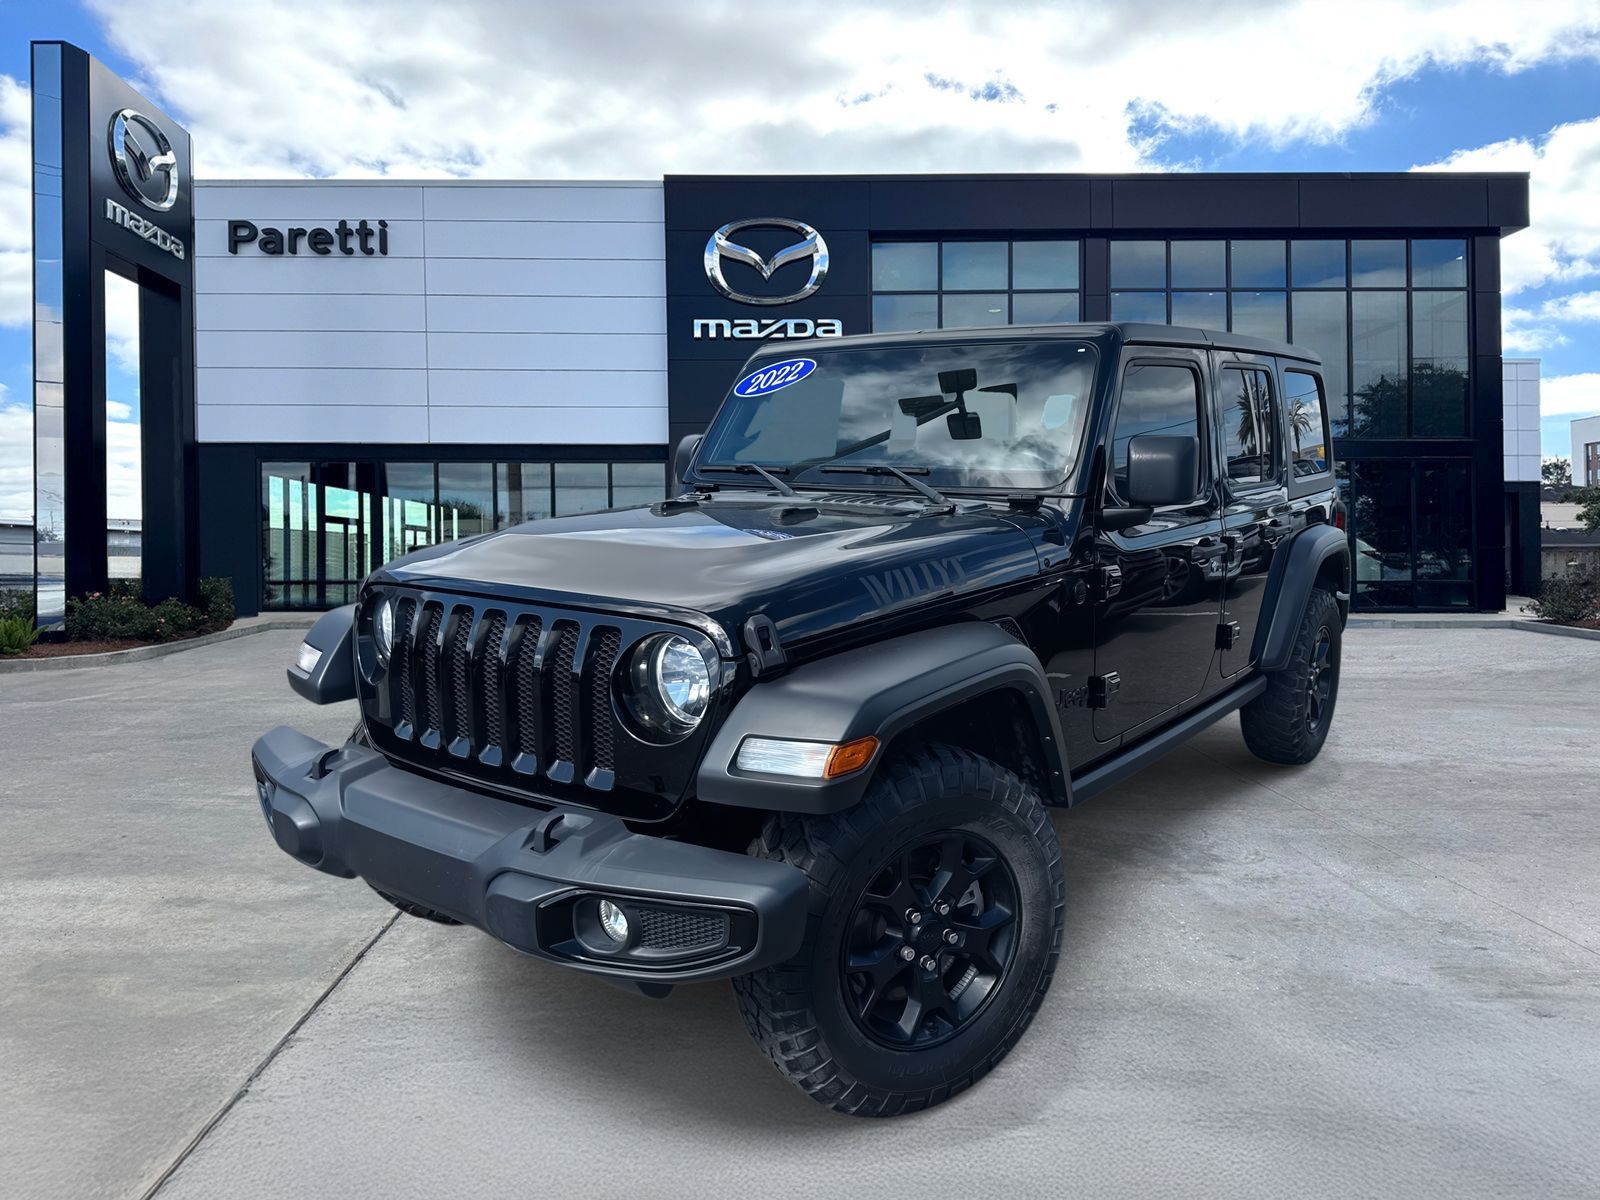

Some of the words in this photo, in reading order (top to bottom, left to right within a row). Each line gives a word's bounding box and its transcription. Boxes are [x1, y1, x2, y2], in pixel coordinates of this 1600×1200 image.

[107, 198, 184, 260] mazda
[228, 219, 388, 256] Paretti
[693, 319, 843, 338] mazda
[745, 361, 805, 394] 2022
